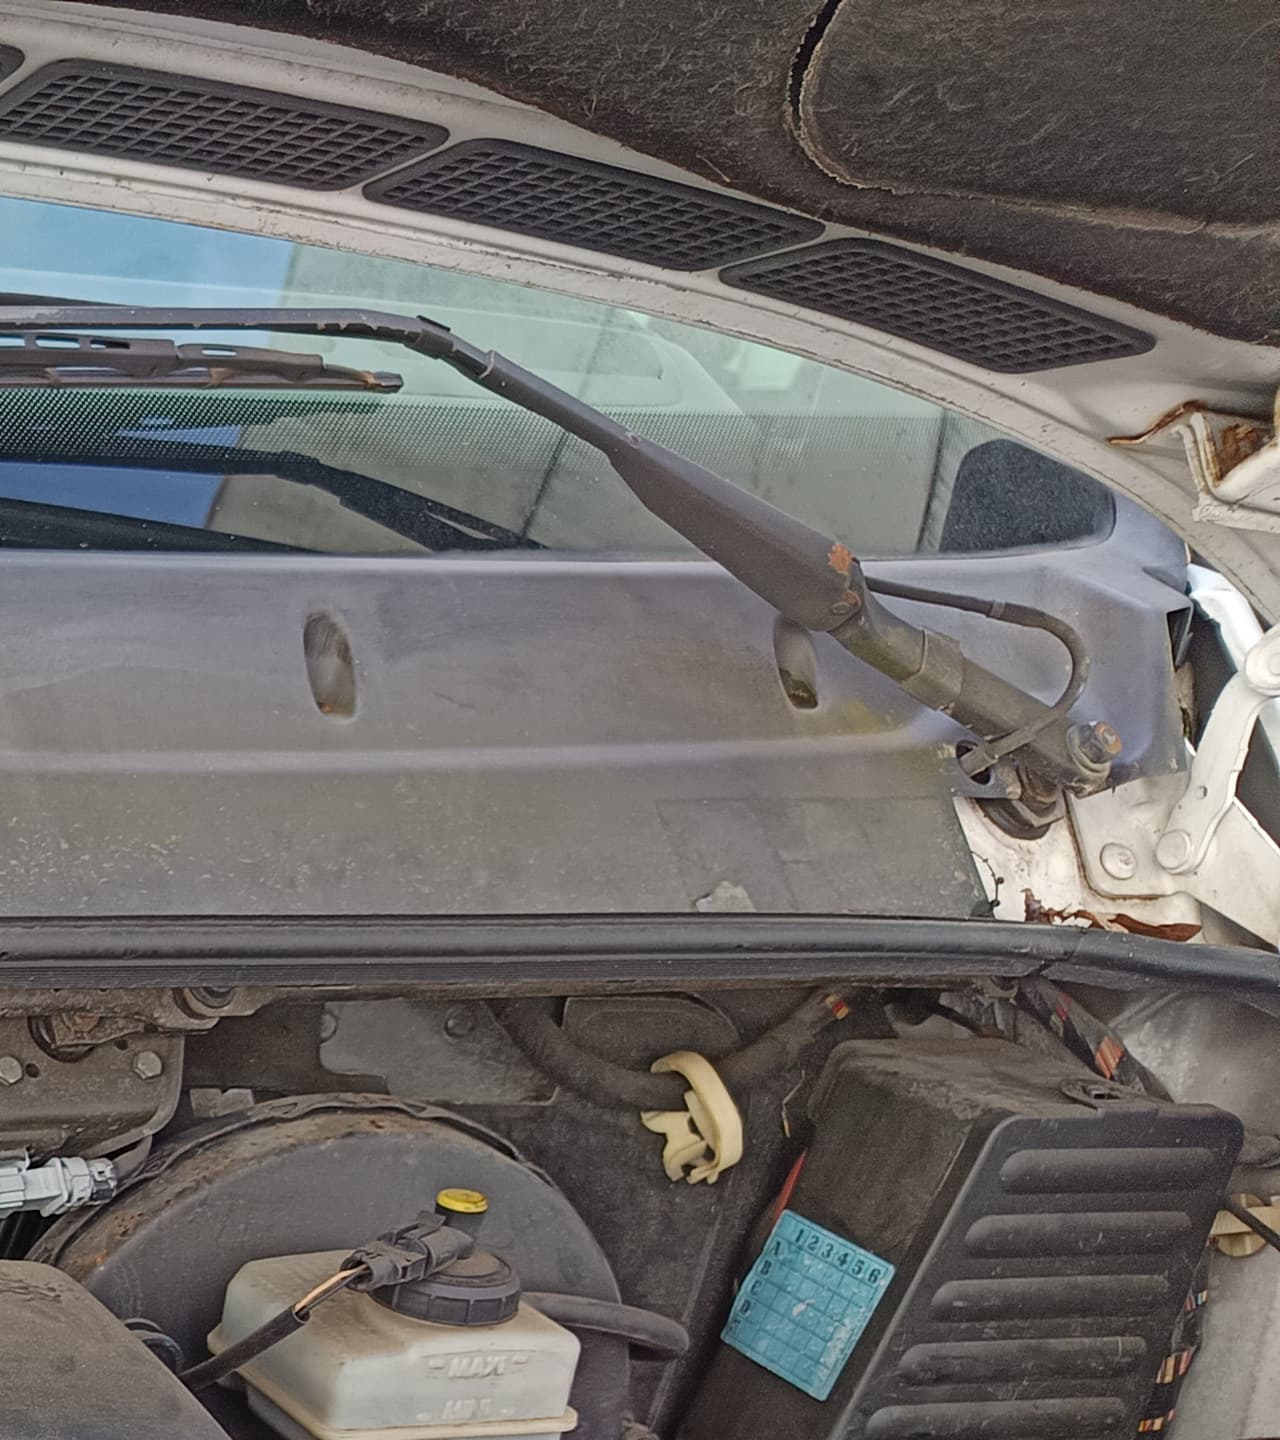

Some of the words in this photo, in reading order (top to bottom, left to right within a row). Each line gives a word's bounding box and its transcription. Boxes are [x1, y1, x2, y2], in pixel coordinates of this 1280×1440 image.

[770, 1241, 781, 1256] A
[793, 1229, 804, 1243] 1
[806, 1235, 818, 1250] 2
[820, 1244, 834, 1260] 3
[837, 1252, 849, 1267] 4
[852, 1260, 865, 1276] 5
[867, 1268, 881, 1285] 6
[759, 1260, 772, 1276] B
[749, 1280, 762, 1297] C
[739, 1300, 751, 1317] D
